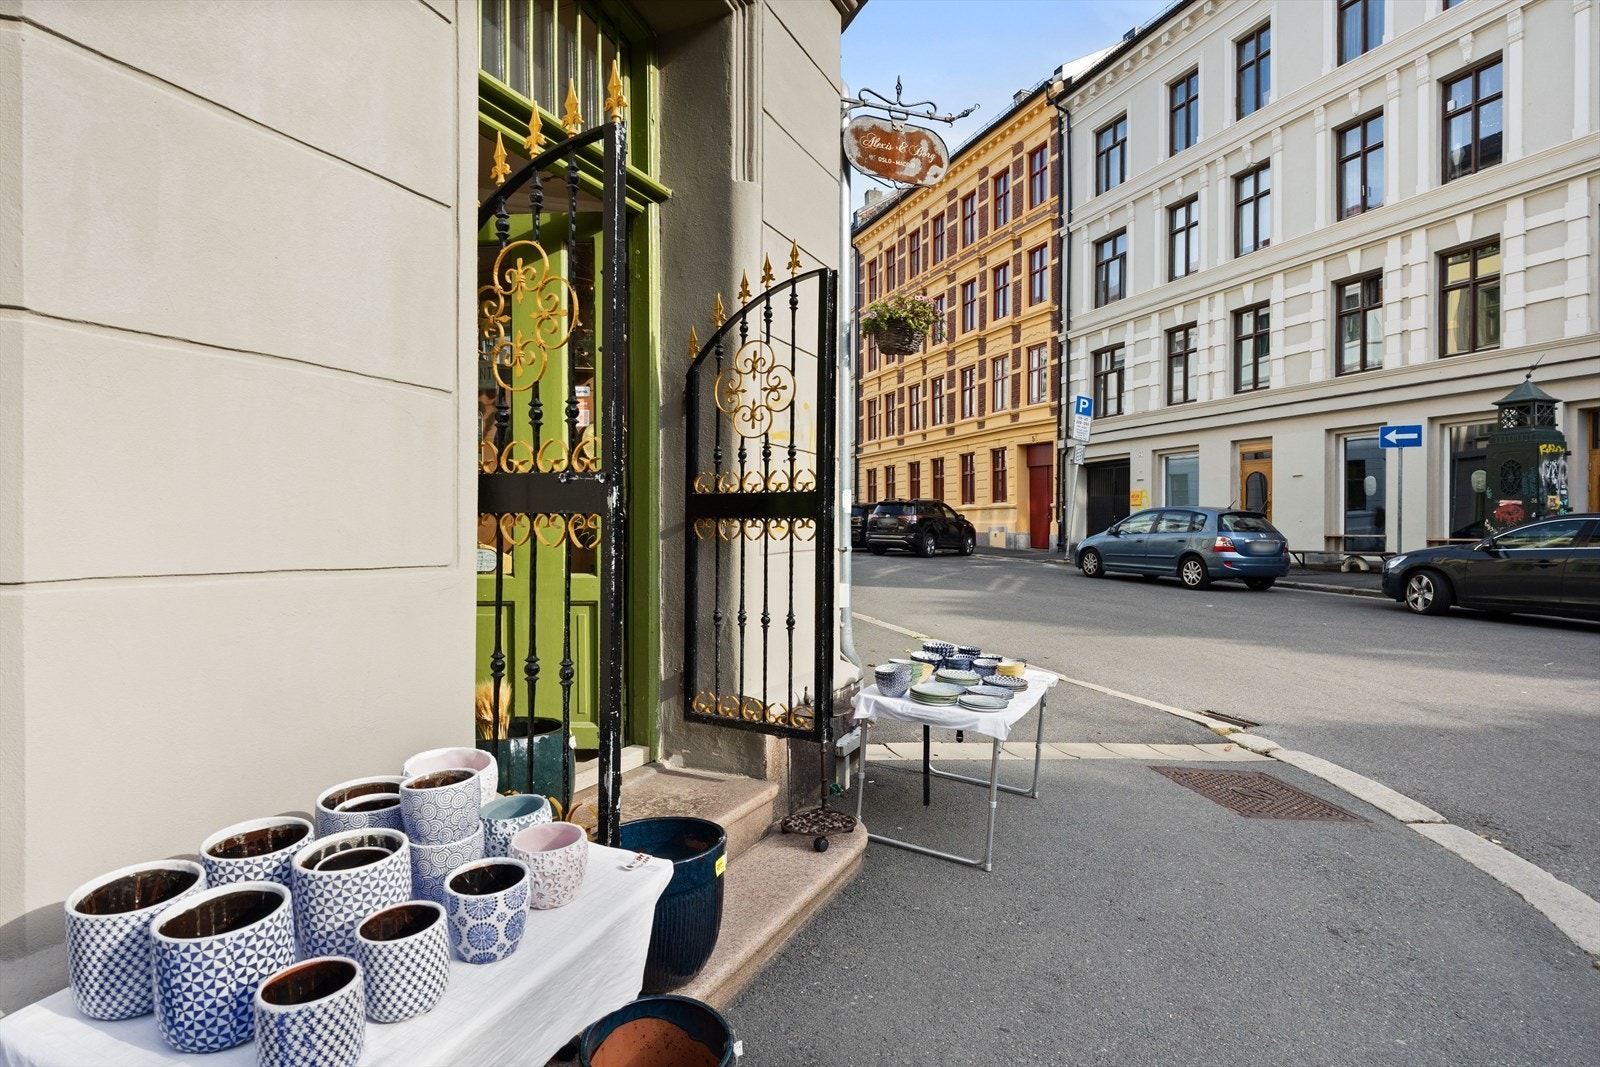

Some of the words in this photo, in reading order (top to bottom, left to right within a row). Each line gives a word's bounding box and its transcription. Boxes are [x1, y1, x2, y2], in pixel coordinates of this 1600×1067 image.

[860, 132, 893, 151] Alexis
[896, 140, 908, 153] &
[1079, 398, 1089, 413] P
